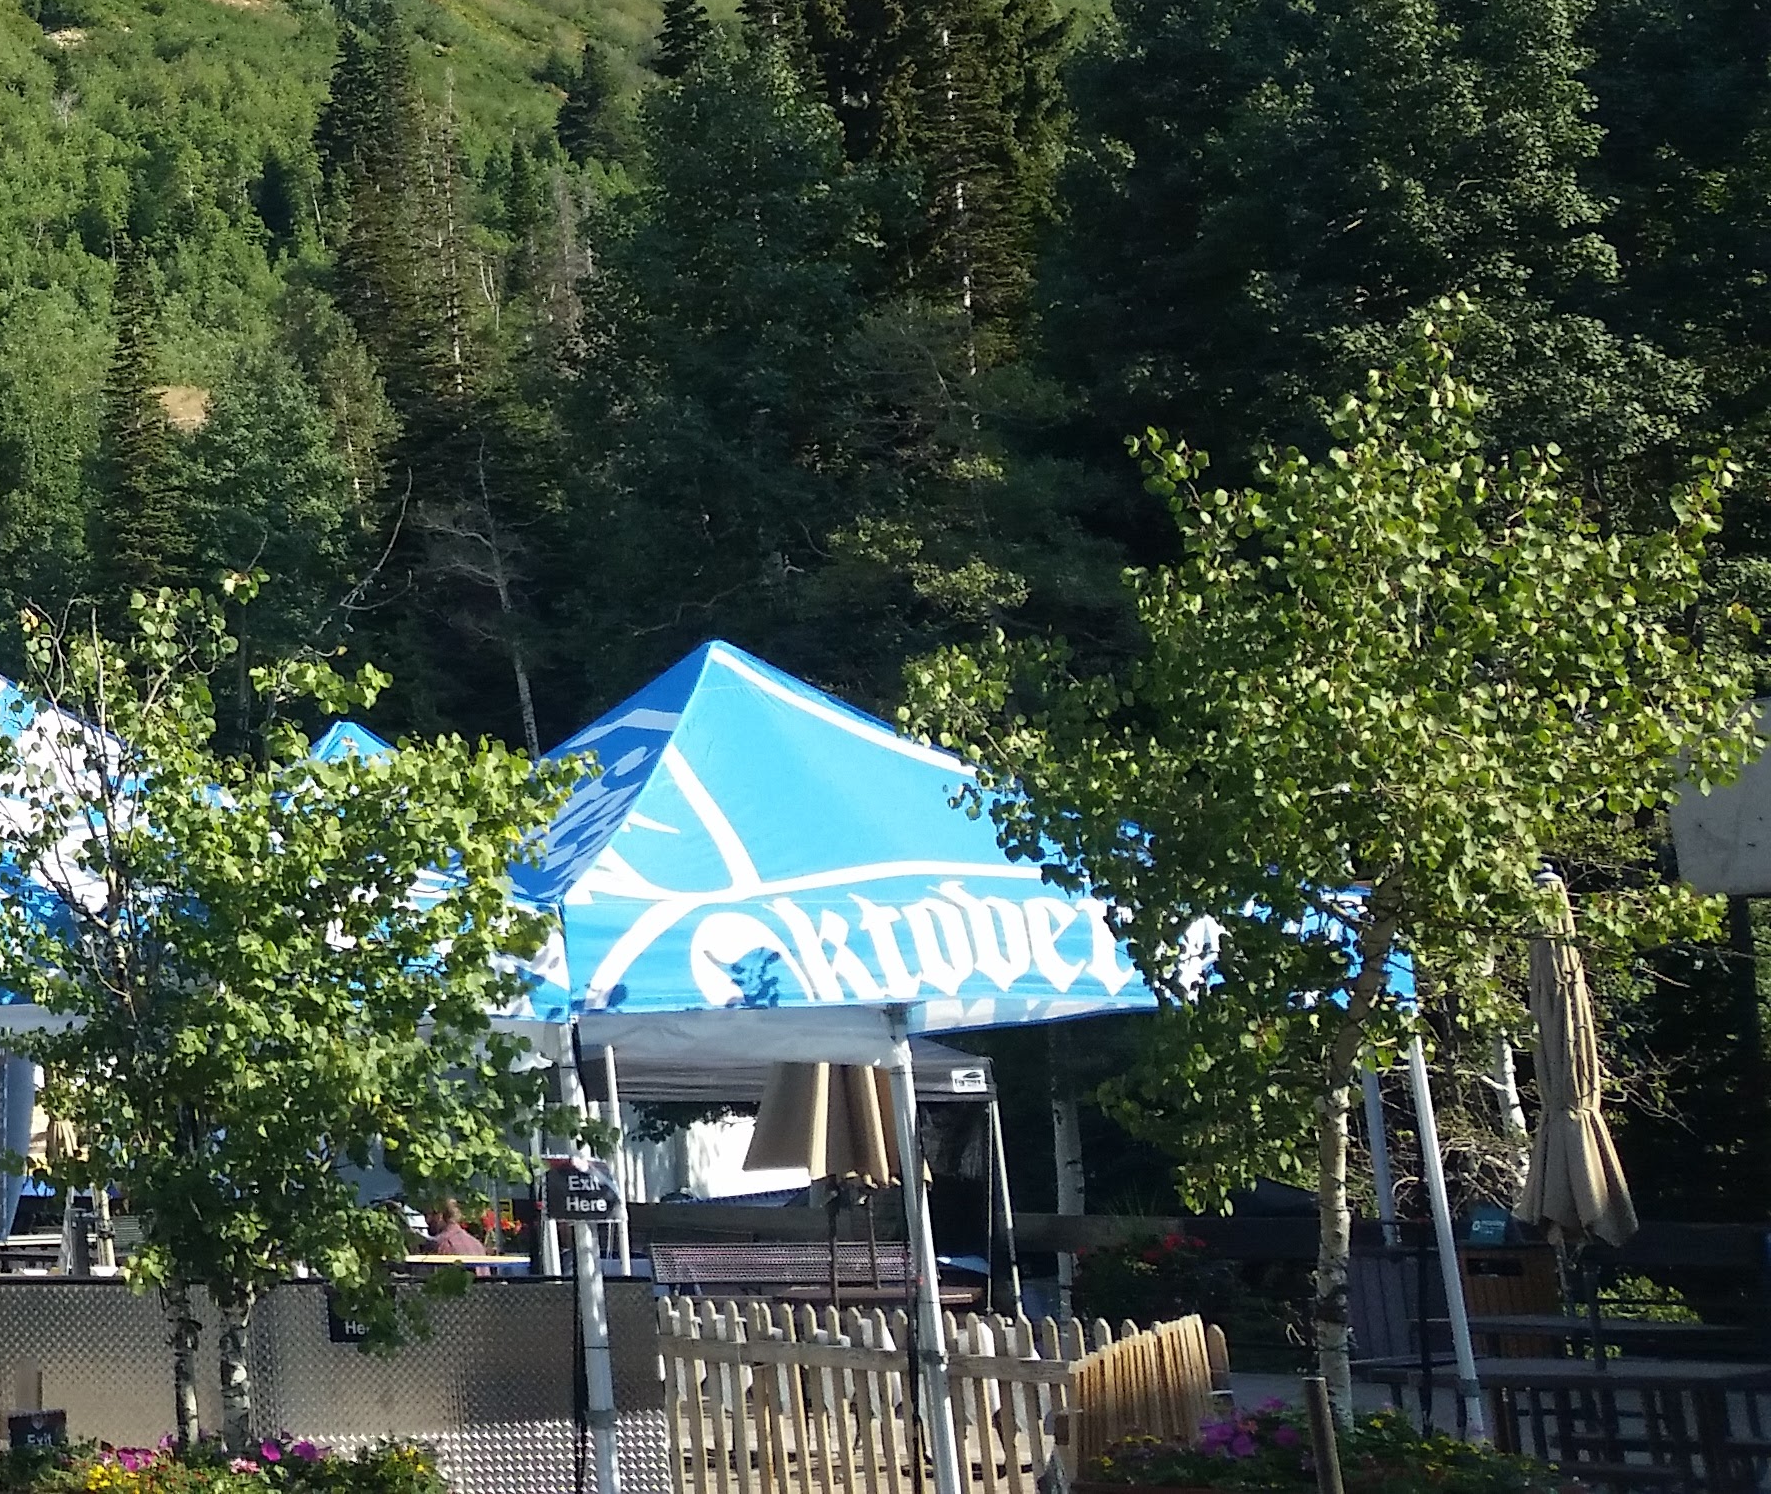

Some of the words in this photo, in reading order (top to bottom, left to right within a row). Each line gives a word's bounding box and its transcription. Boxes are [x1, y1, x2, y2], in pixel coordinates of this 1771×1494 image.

[690, 881, 1159, 1004] Oktober
[568, 1175, 601, 1191] Exit
[566, 1196, 607, 1212] Here
[345, 1321, 369, 1336] He
